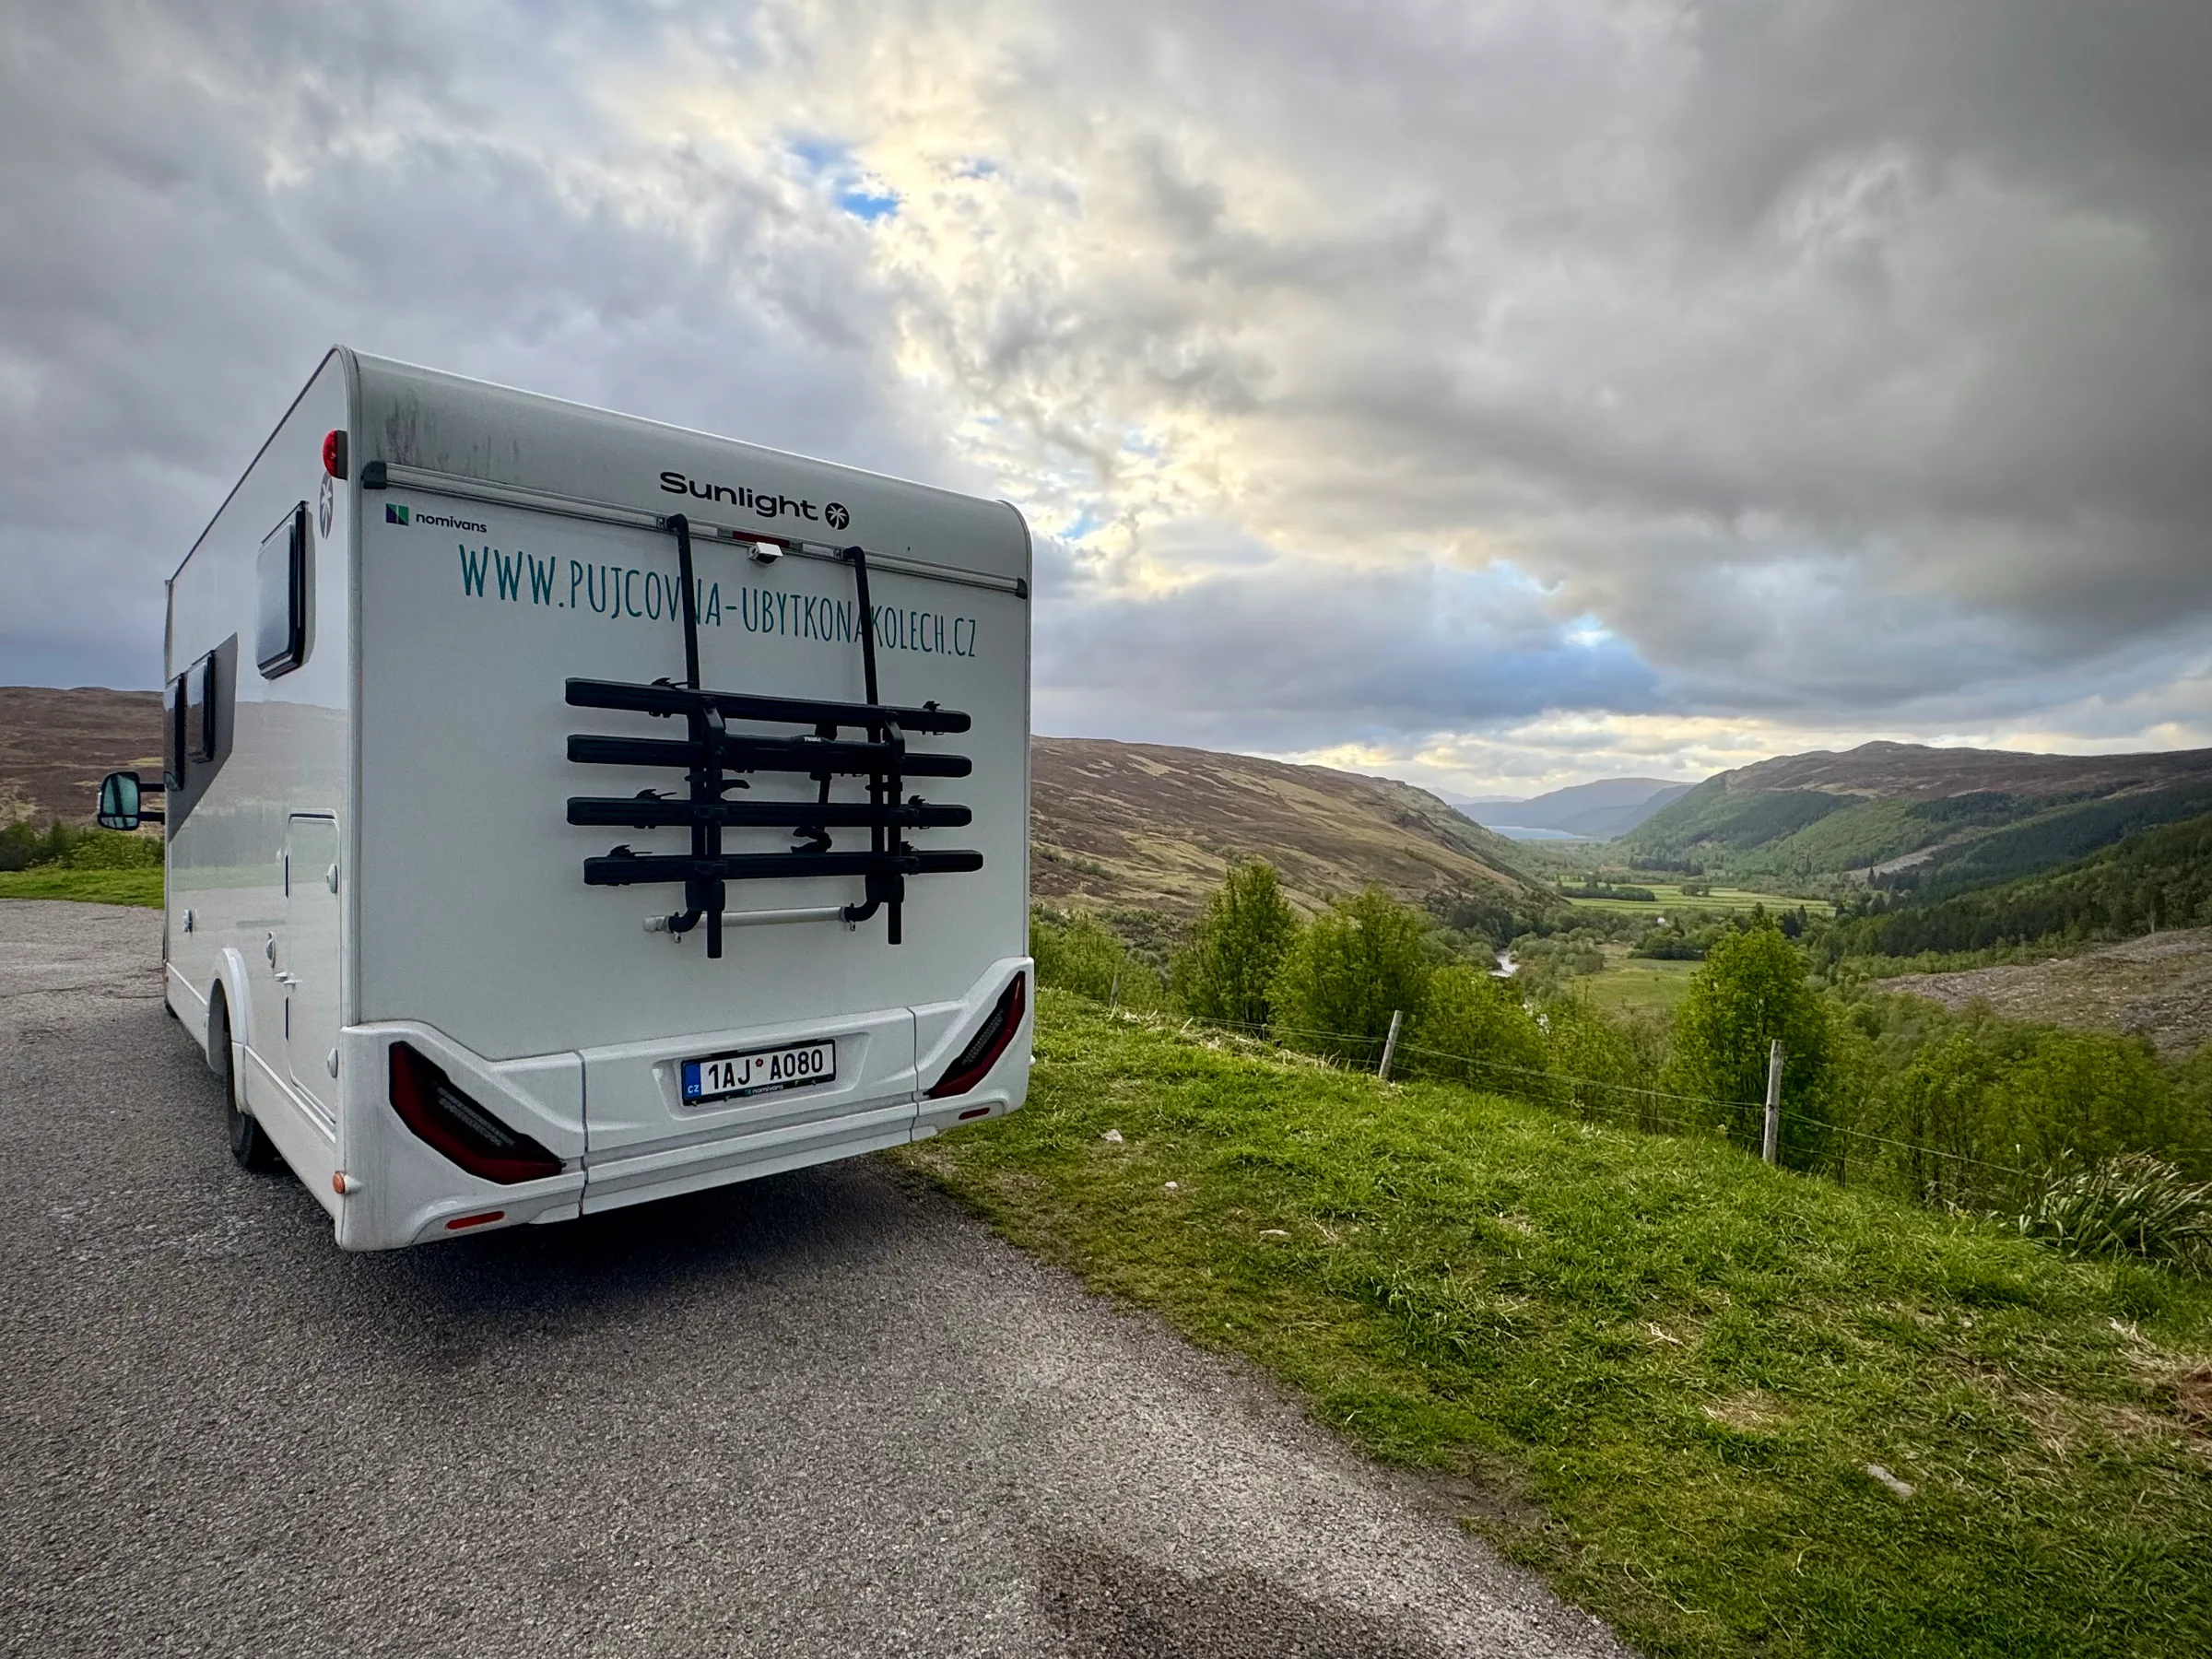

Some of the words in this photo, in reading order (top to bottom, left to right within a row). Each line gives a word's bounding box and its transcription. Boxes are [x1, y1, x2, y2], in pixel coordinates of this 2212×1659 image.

[660, 471, 818, 521] Sunlight
[416, 512, 487, 533] nomivans
[708, 1059, 751, 1089] 1AJ
[770, 1049, 823, 1081] A080
[688, 1083, 700, 1094] CZ
